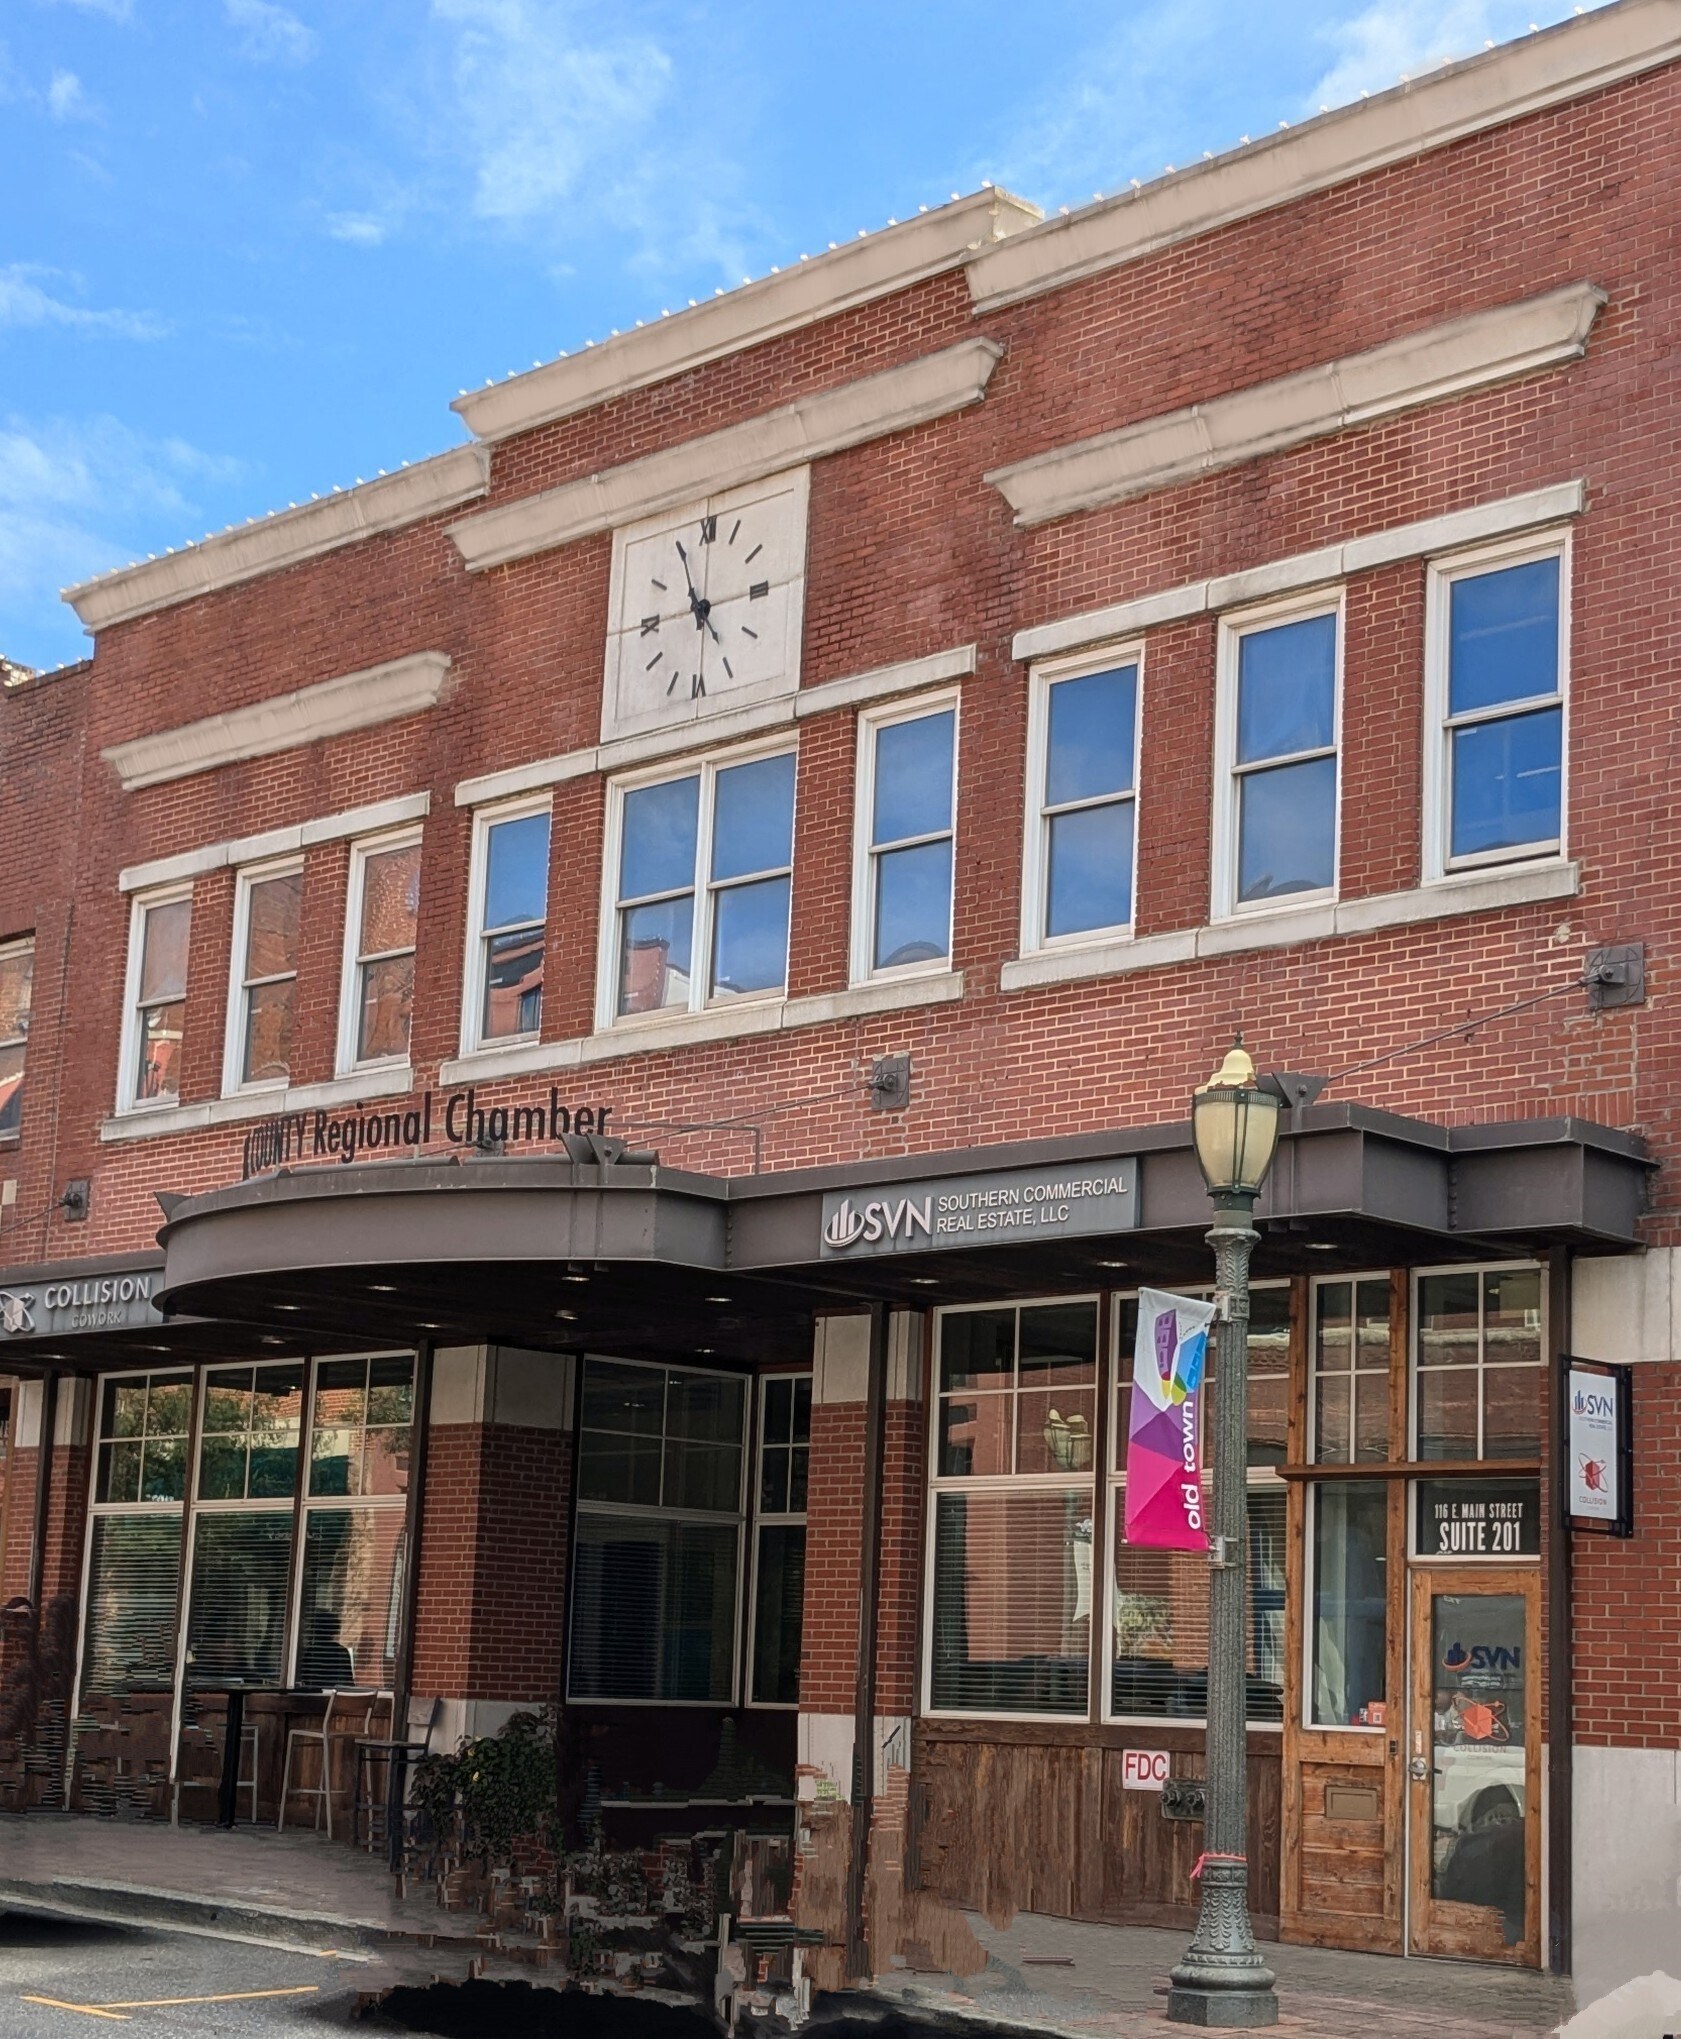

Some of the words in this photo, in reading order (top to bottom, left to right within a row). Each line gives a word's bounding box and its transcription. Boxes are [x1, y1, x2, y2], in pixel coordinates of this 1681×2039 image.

[313, 1091, 431, 1164] Regional
[446, 1087, 613, 1143] Chamber
[937, 1188, 1020, 1213] SOUTHERN
[1023, 1176, 1128, 1203] COMMERCIAL
[862, 1196, 932, 1241] SVN
[936, 1216, 974, 1234] REAL
[977, 1210, 1037, 1230] ESTATE,
[1040, 1205, 1070, 1223] LLC
[44, 1276, 150, 1309] COLLISION
[71, 1310, 122, 1328] COWORK
[1587, 1394, 1614, 1417] SVN
[1183, 1401, 1196, 1473] town
[1180, 1483, 1201, 1530] old
[1434, 1503, 1449, 1519] 116
[1461, 1503, 1486, 1519] MAIN
[1489, 1502, 1524, 1518] STREET
[1440, 1521, 1487, 1551] SUITE
[1492, 1521, 1521, 1551] 201
[1471, 1646, 1521, 1670] SVN
[1125, 1753, 1166, 1781] FDC
